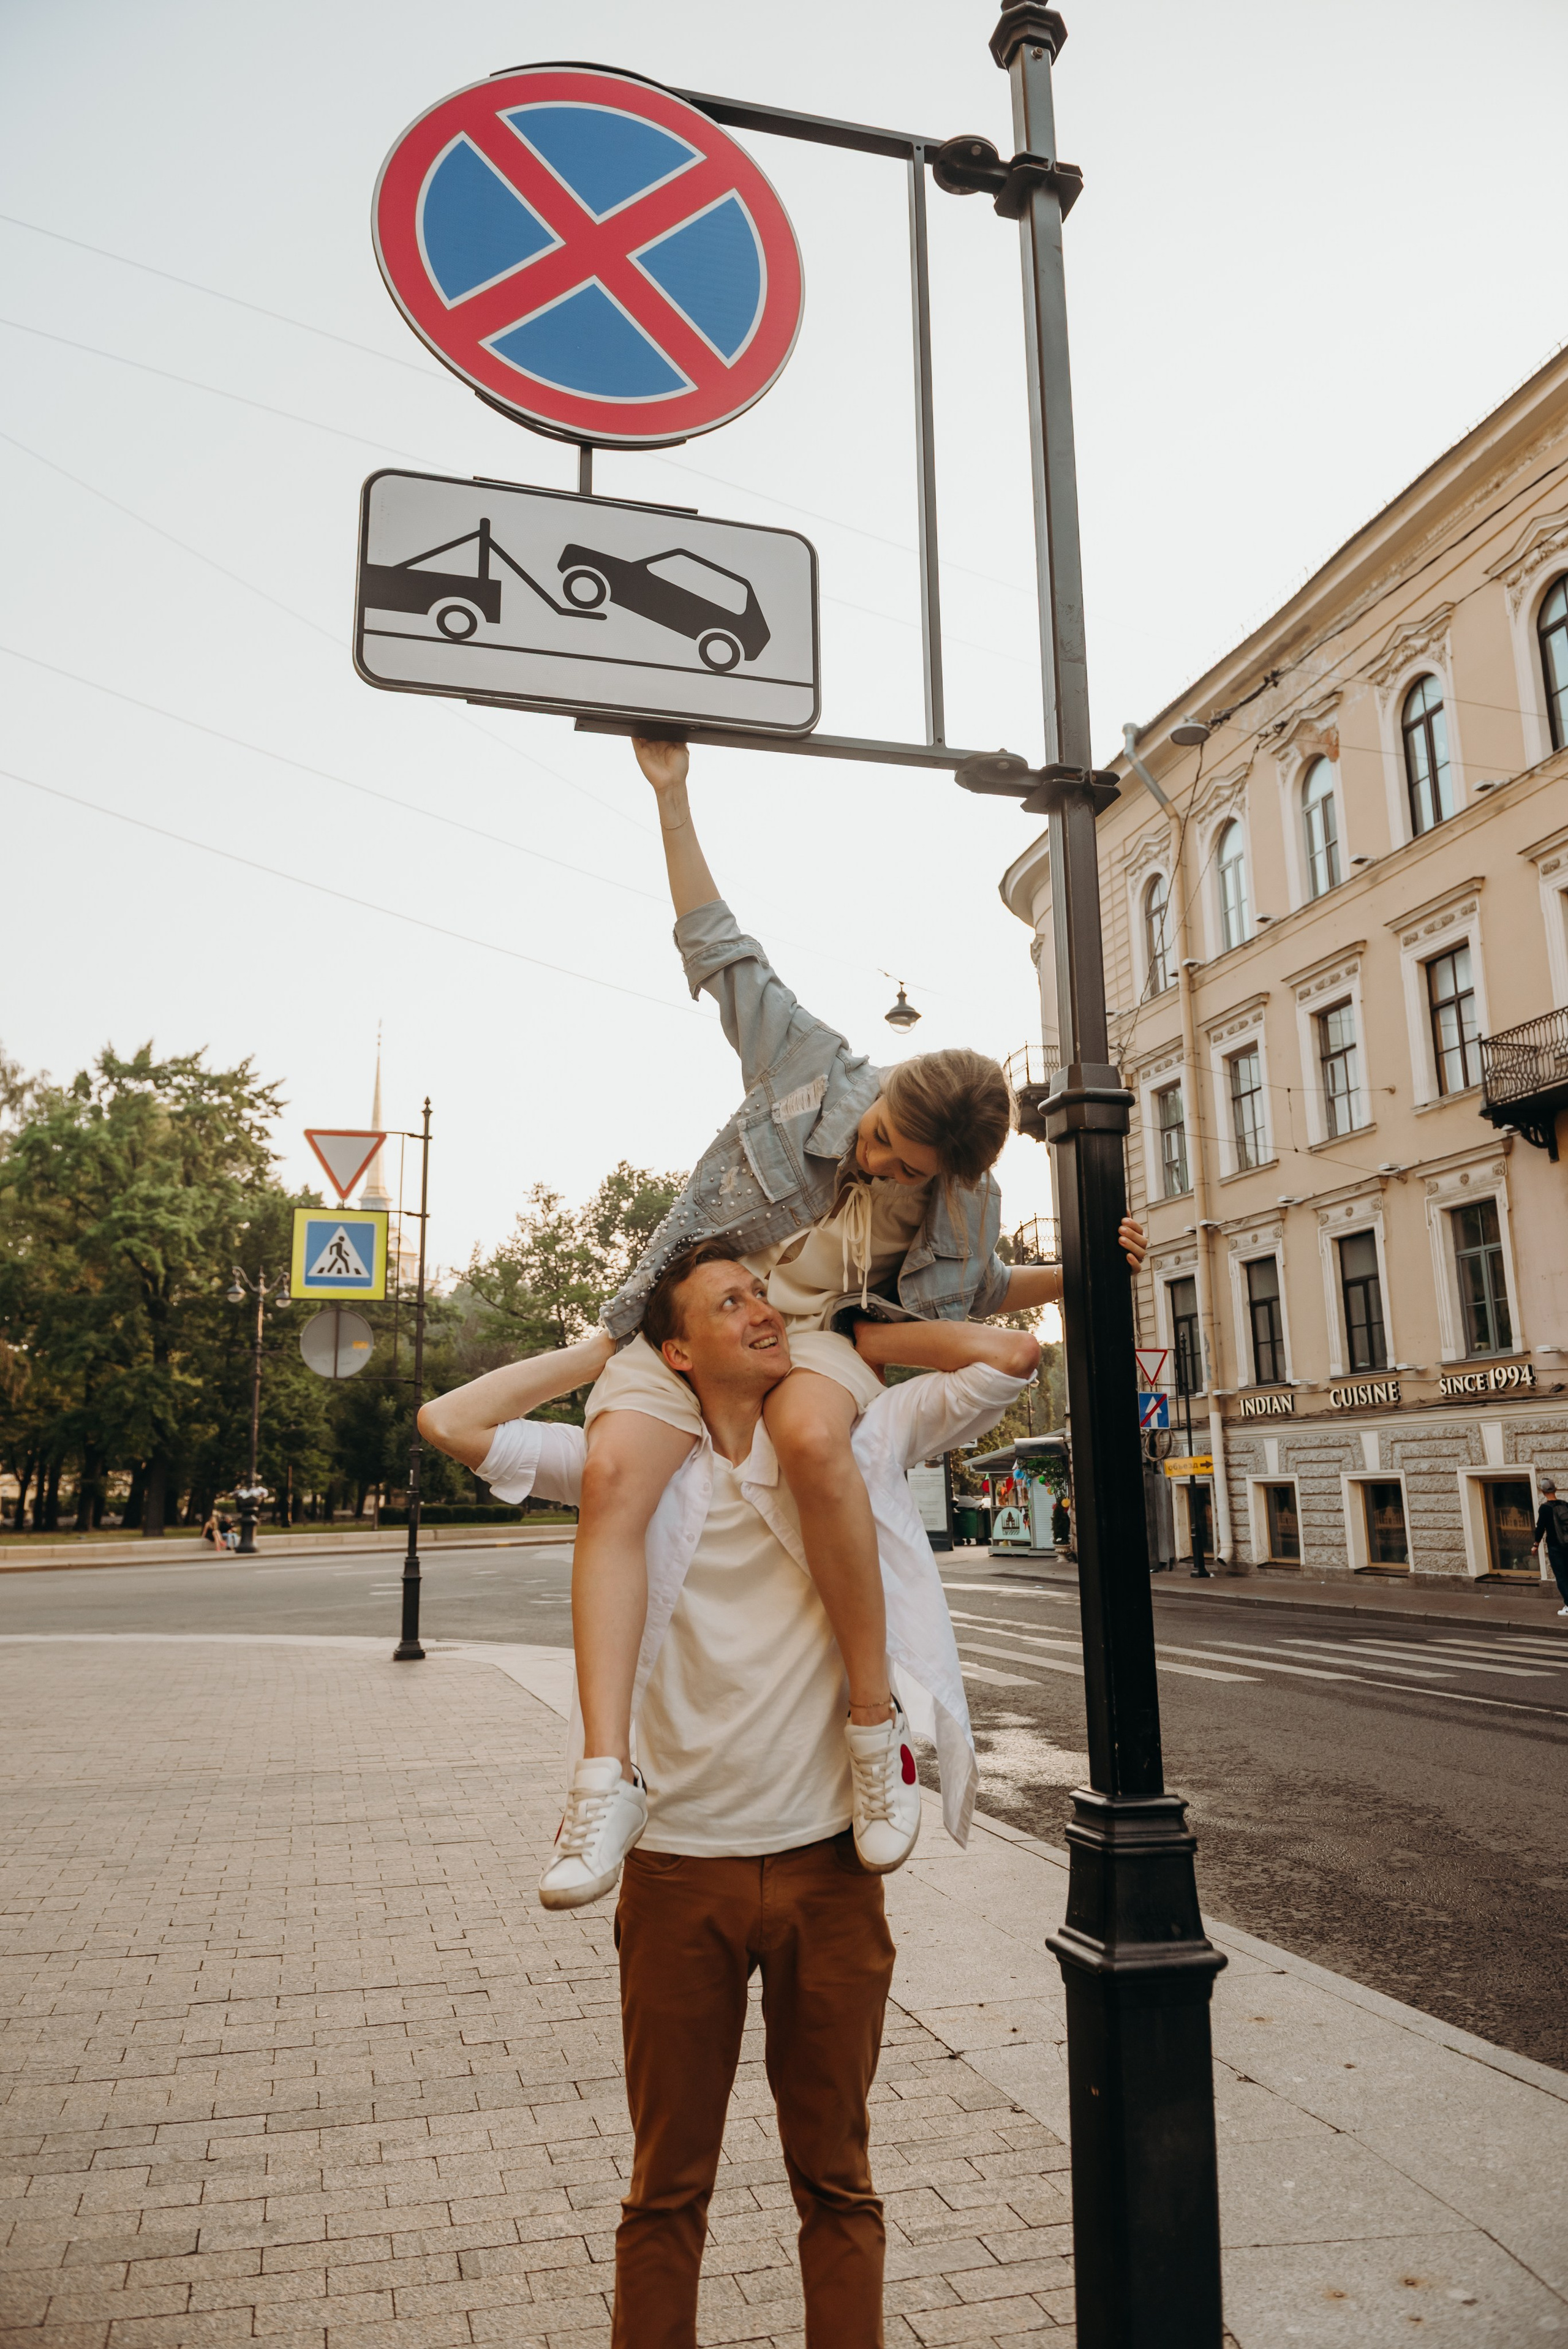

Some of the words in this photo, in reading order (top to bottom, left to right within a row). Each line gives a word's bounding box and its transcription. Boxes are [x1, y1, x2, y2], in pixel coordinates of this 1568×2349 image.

[1240, 1394, 1294, 1416] INDIAN
[1330, 1381, 1400, 1408] CUISINE
[1439, 1373, 1488, 1395] SINCE
[1488, 1364, 1534, 1390] 1994
